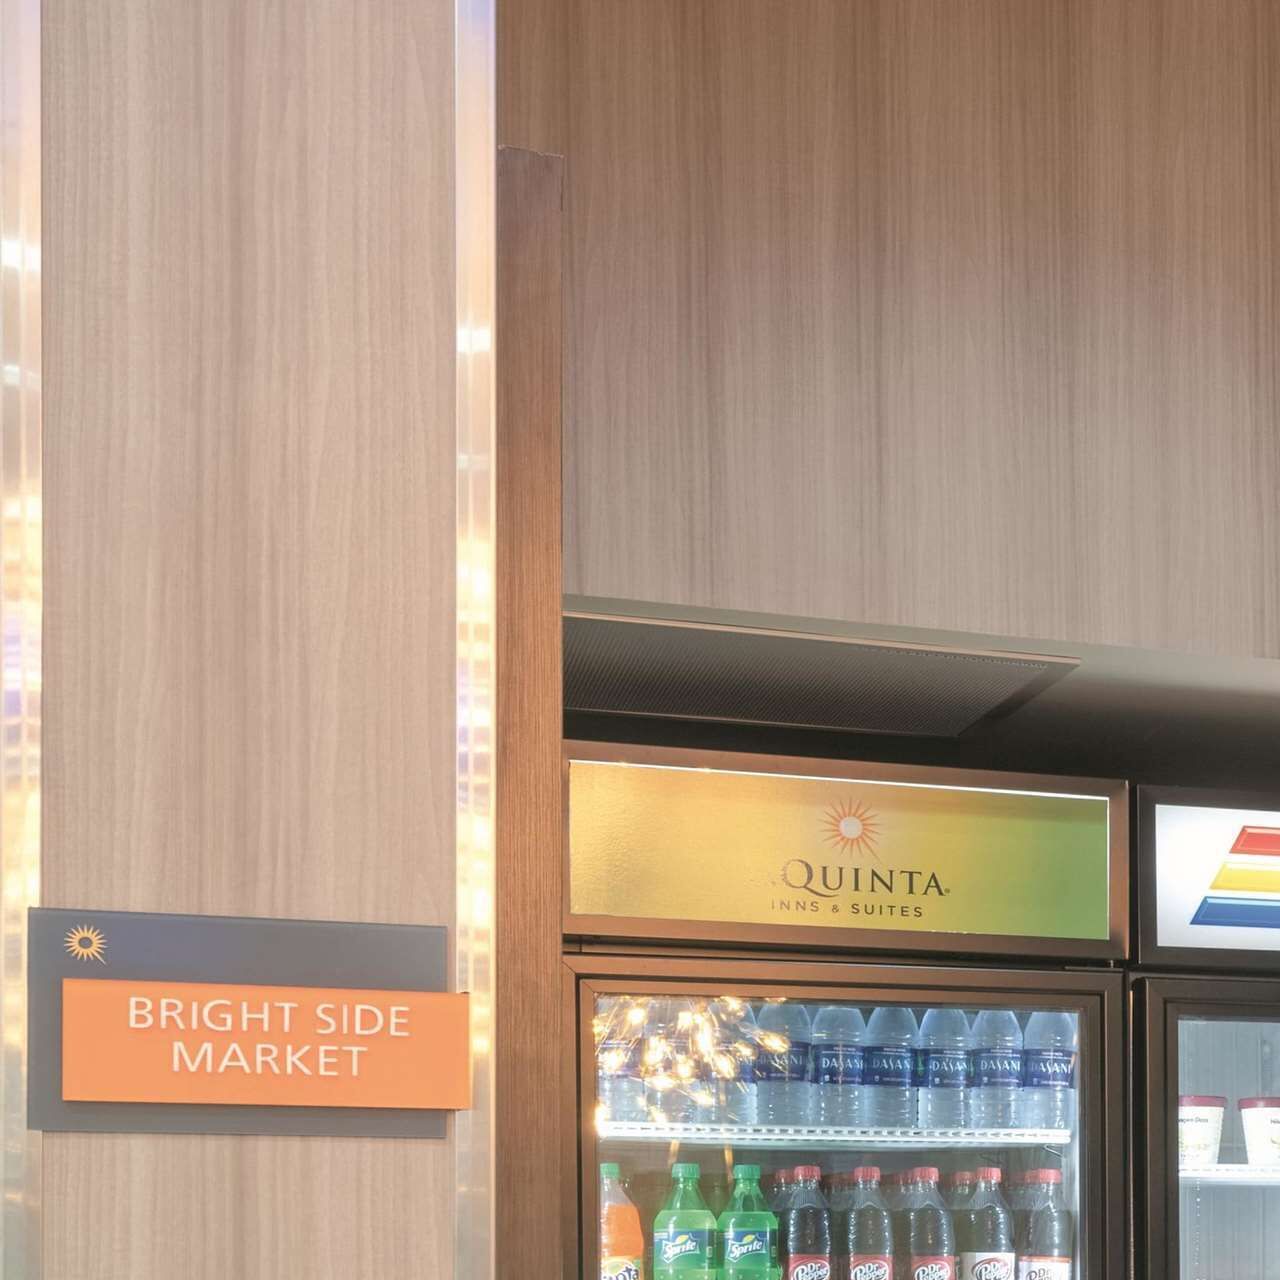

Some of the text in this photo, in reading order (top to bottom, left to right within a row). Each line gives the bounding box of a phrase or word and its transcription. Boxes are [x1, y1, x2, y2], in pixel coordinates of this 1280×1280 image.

[782, 858, 945, 898] QUINTA
[771, 899, 923, 917] INNS & SUITES
[127, 996, 412, 1038] BRIGHT SIDE
[171, 1041, 368, 1077] MARKET
[663, 1240, 699, 1259] Sprite
[730, 1240, 765, 1258] Sprite
[807, 1262, 822, 1273] Dr
[865, 1263, 879, 1274] Dr
[928, 1263, 941, 1274] Dr
[993, 1261, 1003, 1274] Dr
